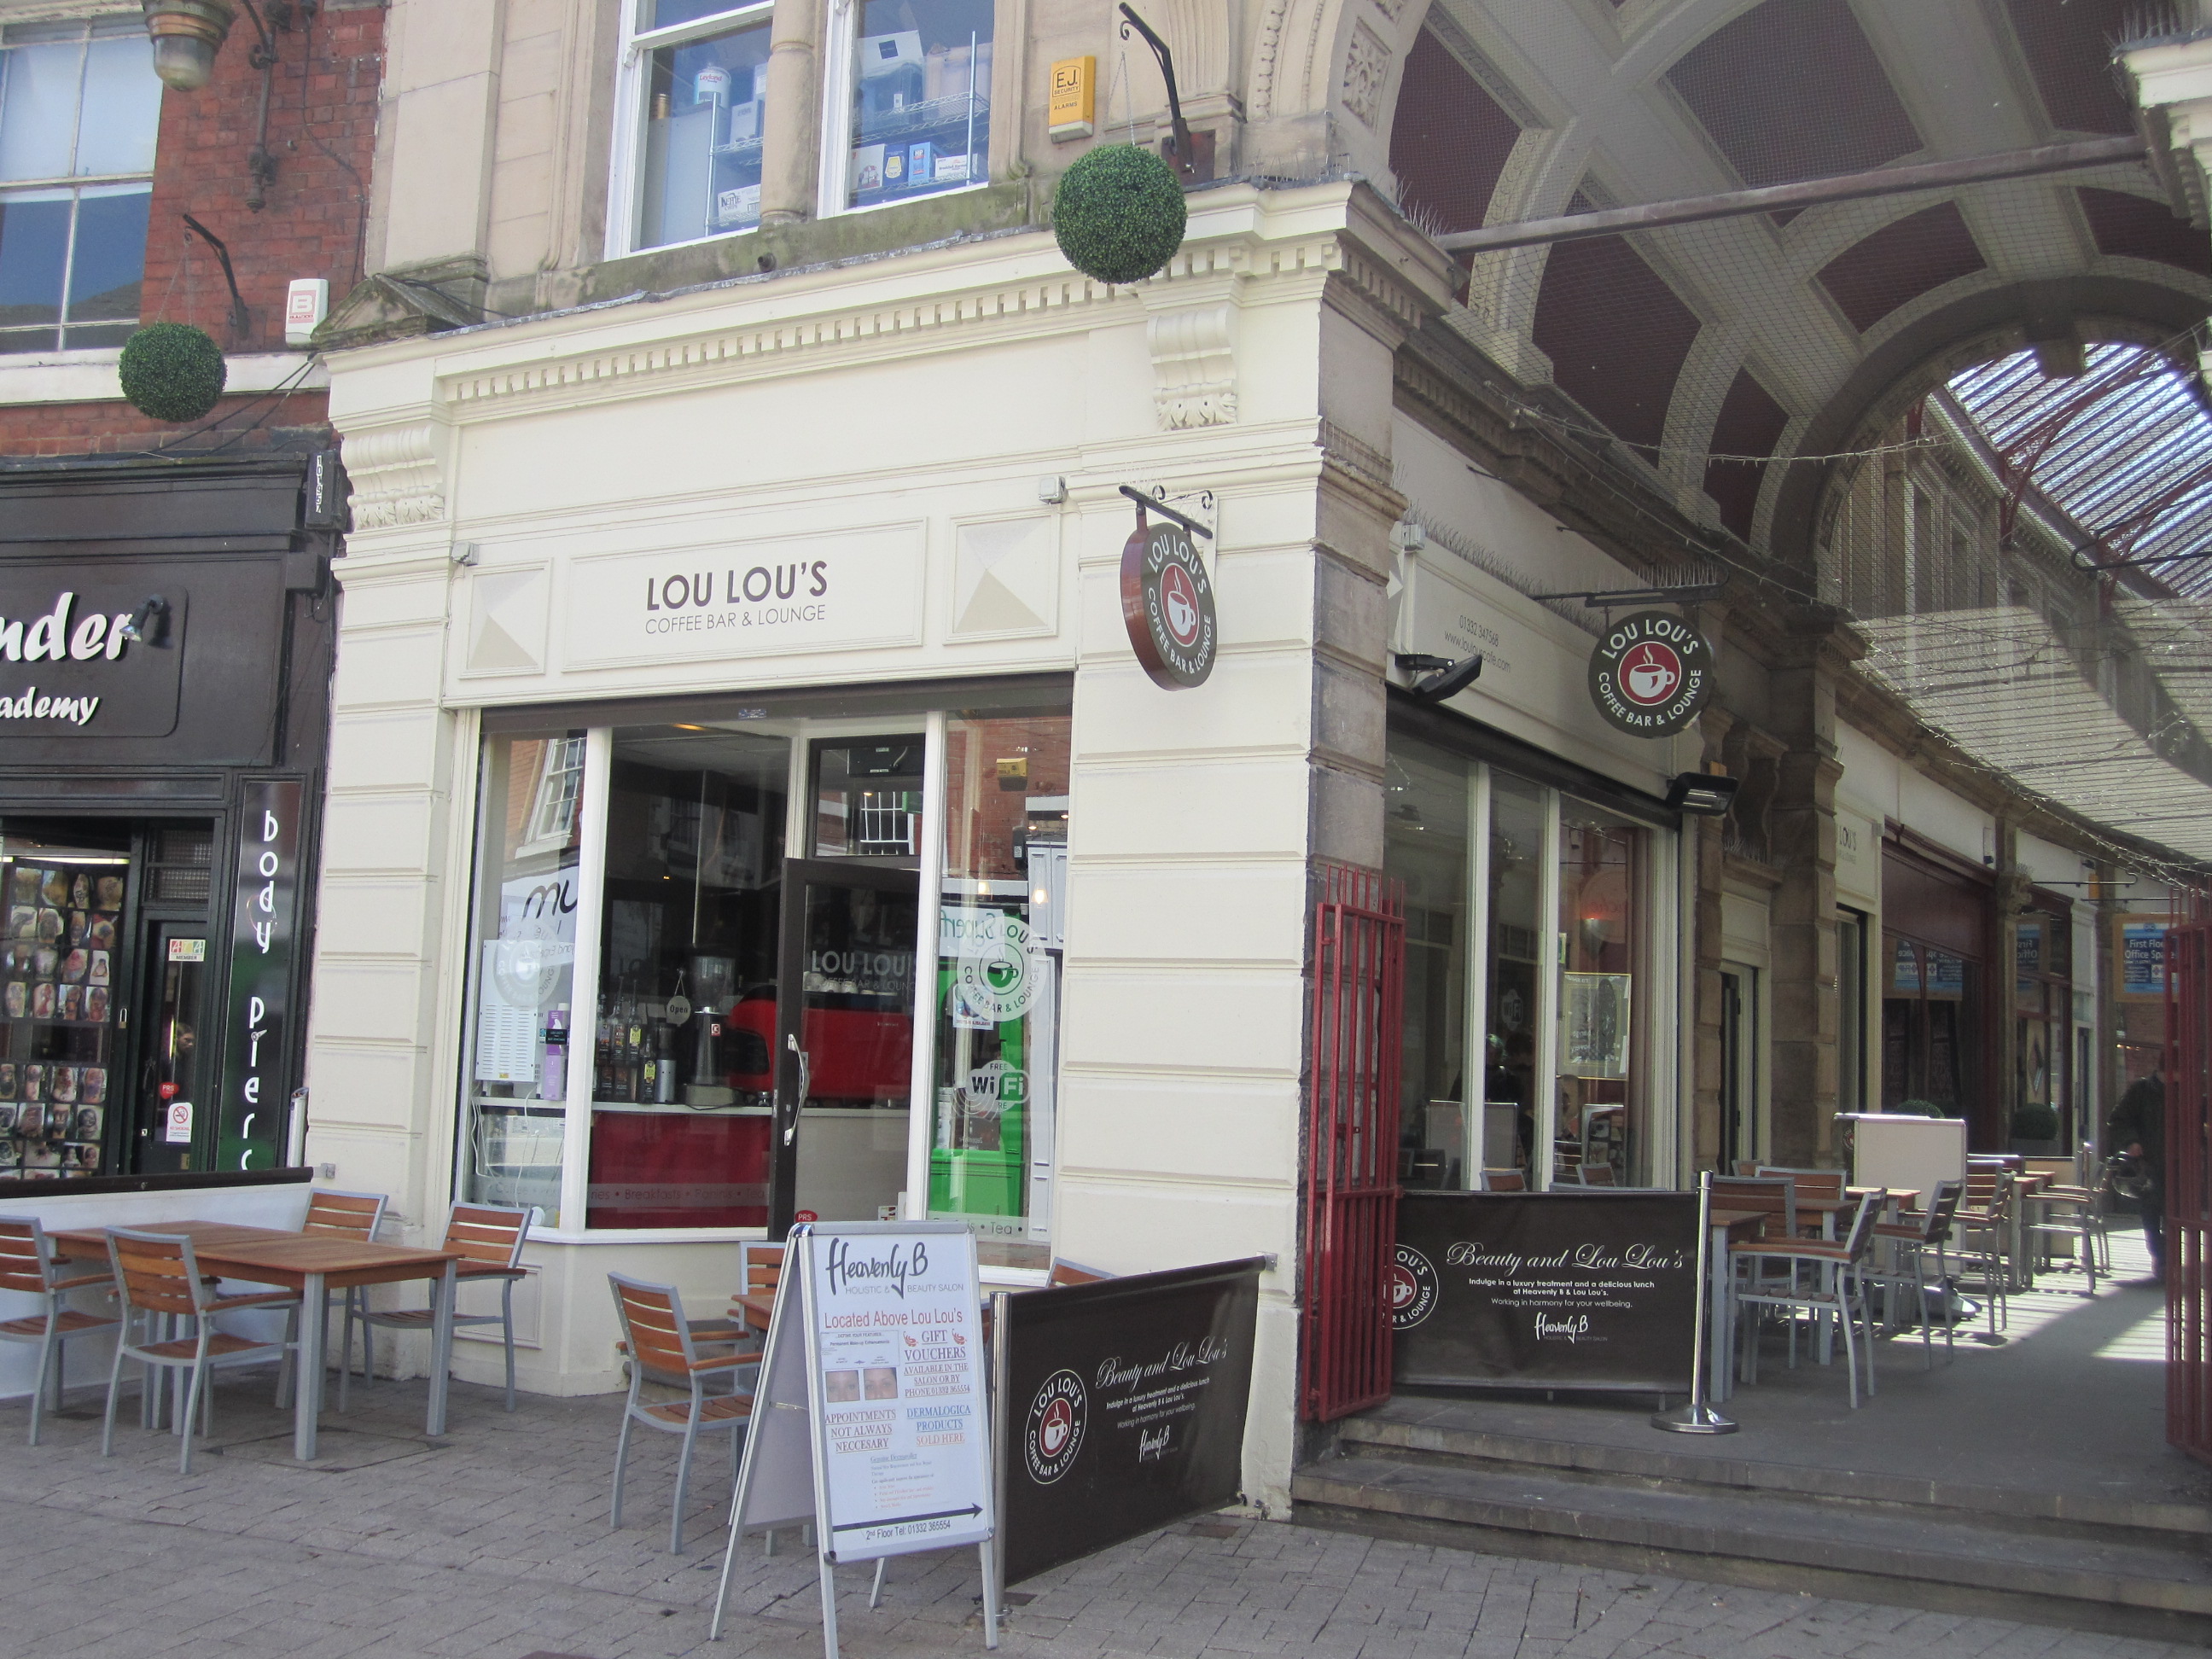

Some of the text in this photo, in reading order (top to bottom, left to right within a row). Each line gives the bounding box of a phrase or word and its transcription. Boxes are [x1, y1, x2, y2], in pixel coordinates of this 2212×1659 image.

[1054, 86, 1079, 96] SECURITY
[1054, 102, 1077, 110] ALARMS
[292, 294, 312, 312] B
[1148, 533, 1206, 594] LOU LOU'S
[647, 560, 827, 610] LOU LOU'S
[645, 604, 826, 634] COFFEE BAR & LOUNGE
[1148, 587, 1211, 674] COFFEE BAR & LOUNGE
[1601, 619, 1698, 659] LOU LOU'S
[1598, 669, 1702, 726] COFFEE BAR & LOUNGE
[2124, 950, 2149, 958] Office
[812, 950, 854, 974] LOU
[1005, 1004, 1011, 1013] &
[1014, 967, 1039, 1008] LOUNGE
[670, 1004, 688, 1014] Open
[625, 1188, 681, 1200] Breakfasts
[990, 1221, 1012, 1235] Tea
[1447, 1242, 1684, 1277] Beauty and Lou Lou's
[825, 1237, 928, 1299] Heavenly B
[845, 1285, 881, 1295] HOLISTIC
[907, 1284, 936, 1293] BEAUTY
[938, 1284, 963, 1292] SALON
[1407, 1286, 1430, 1320] LOUNGE
[1491, 1298, 1519, 1307] Working
[824, 1307, 963, 1329] Located Above Lou Lou's
[1534, 1312, 1588, 1343] Heavenly B
[922, 1330, 947, 1342] GIFT
[904, 1347, 966, 1361] VOUCHERS
[904, 1364, 944, 1375] AVAILABLE
[1095, 1356, 1144, 1393] Beauty
[1144, 1351, 1171, 1377] and
[1169, 1342, 1196, 1371] Lou
[914, 1377, 937, 1385] SALON
[905, 1388, 930, 1397] PHONE
[1033, 1377, 1082, 1417] LOU LOU'S
[824, 1409, 896, 1423] APPOINTMENTS
[906, 1405, 971, 1417] DERMALOGICA
[831, 1423, 893, 1437] NOT ALWAYS
[917, 1418, 963, 1431] PRODUCTS
[835, 1438, 889, 1452] NECCESARY
[917, 1433, 964, 1445] SOLD HERE
[1028, 1420, 1081, 1476] COFFEE BAR & LOUNGE
[866, 1530, 876, 1540] 2nd
[876, 1528, 893, 1539] Floor
[894, 1526, 906, 1535] Tel:
[908, 1523, 927, 1534] 01332
